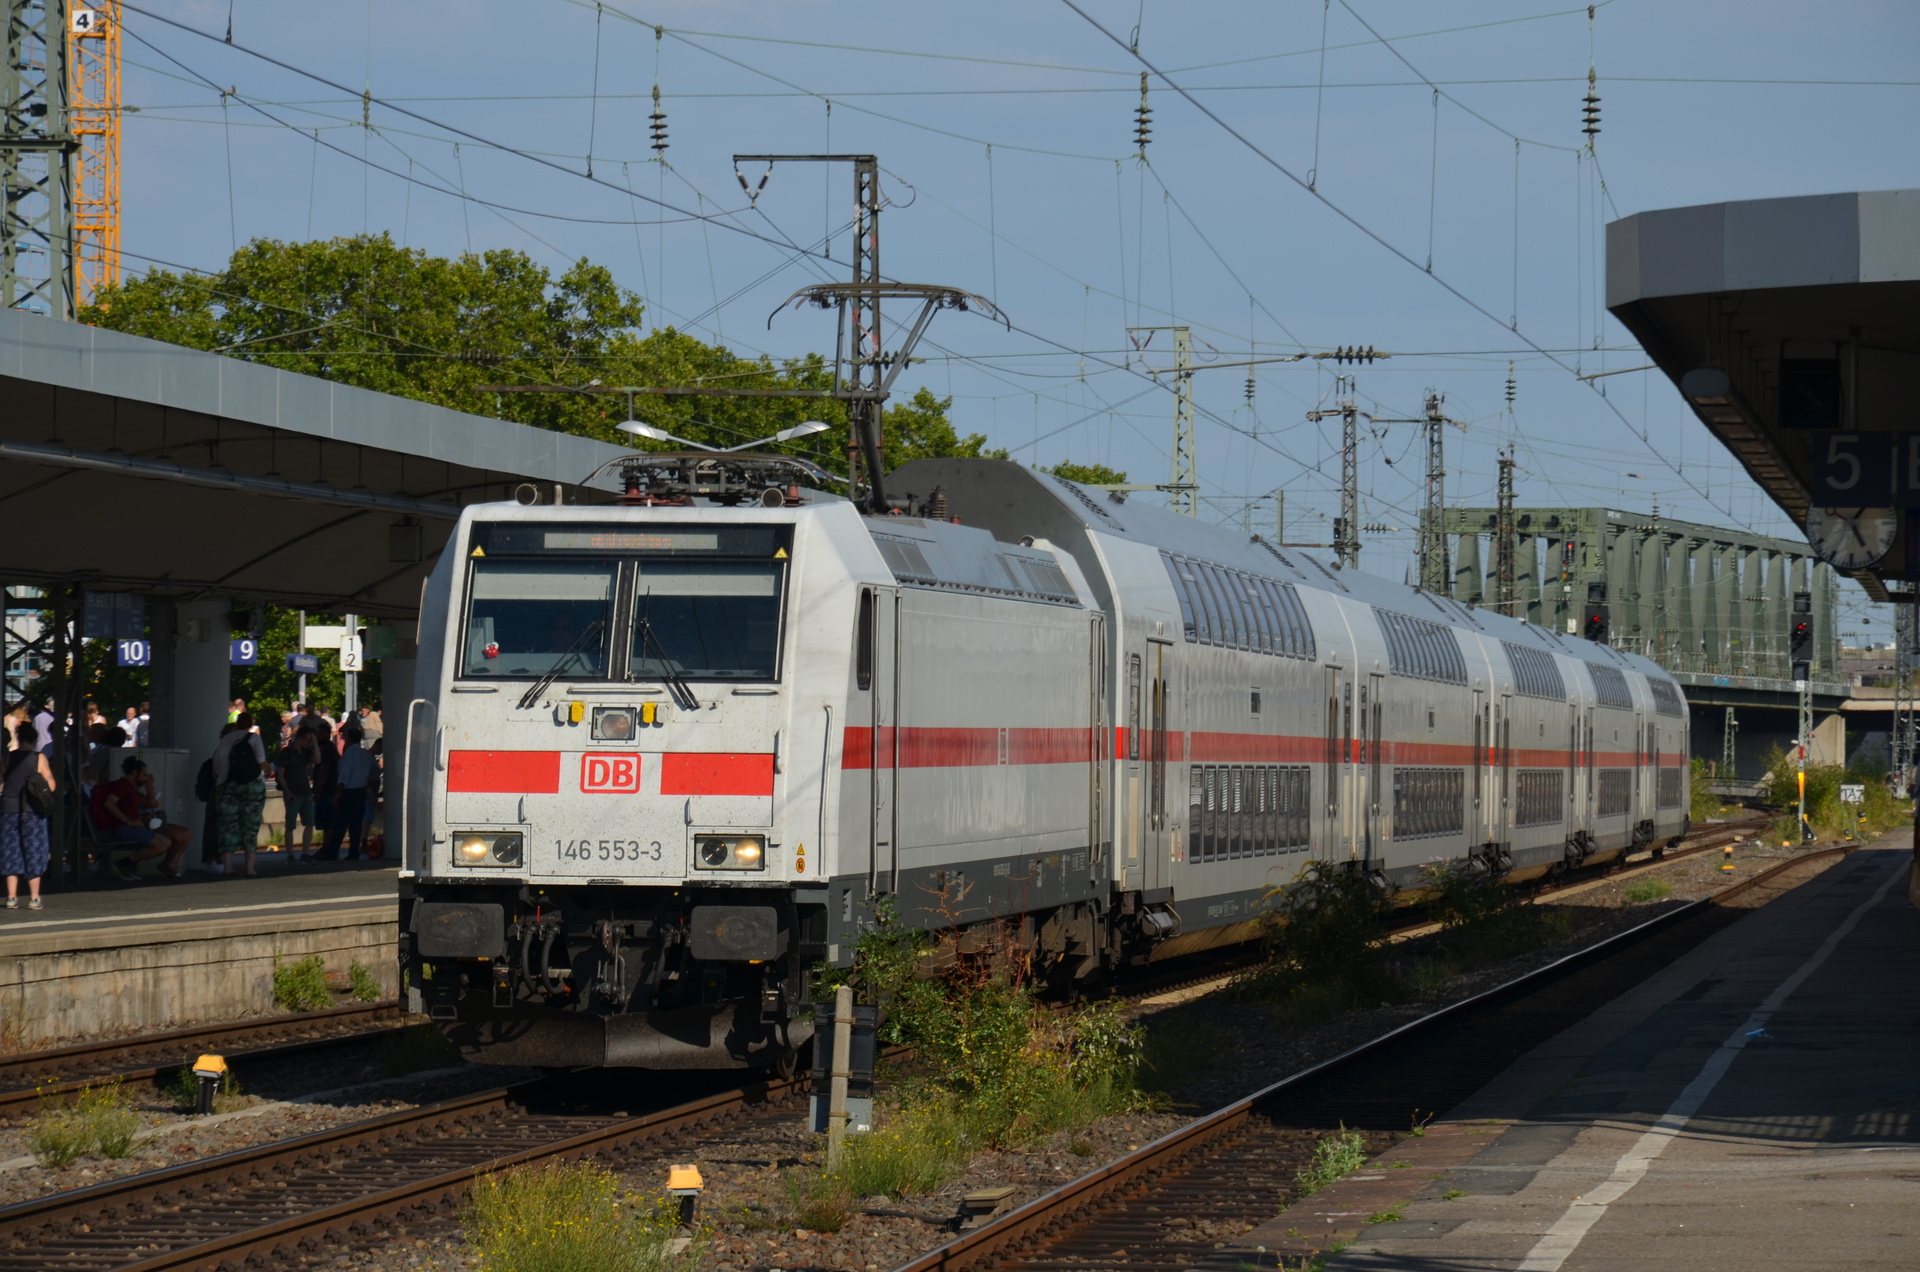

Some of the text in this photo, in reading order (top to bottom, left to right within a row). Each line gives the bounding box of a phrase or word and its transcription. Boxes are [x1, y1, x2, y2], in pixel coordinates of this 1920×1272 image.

[76, 13, 89, 29] 4
[1824, 435, 1861, 490] 5
[120, 641, 144, 661] 10
[240, 640, 254, 660] 9
[348, 637, 354, 652] 1
[347, 653, 356, 667] 2
[587, 759, 634, 787] DB
[555, 839, 662, 861] 146 553-3
